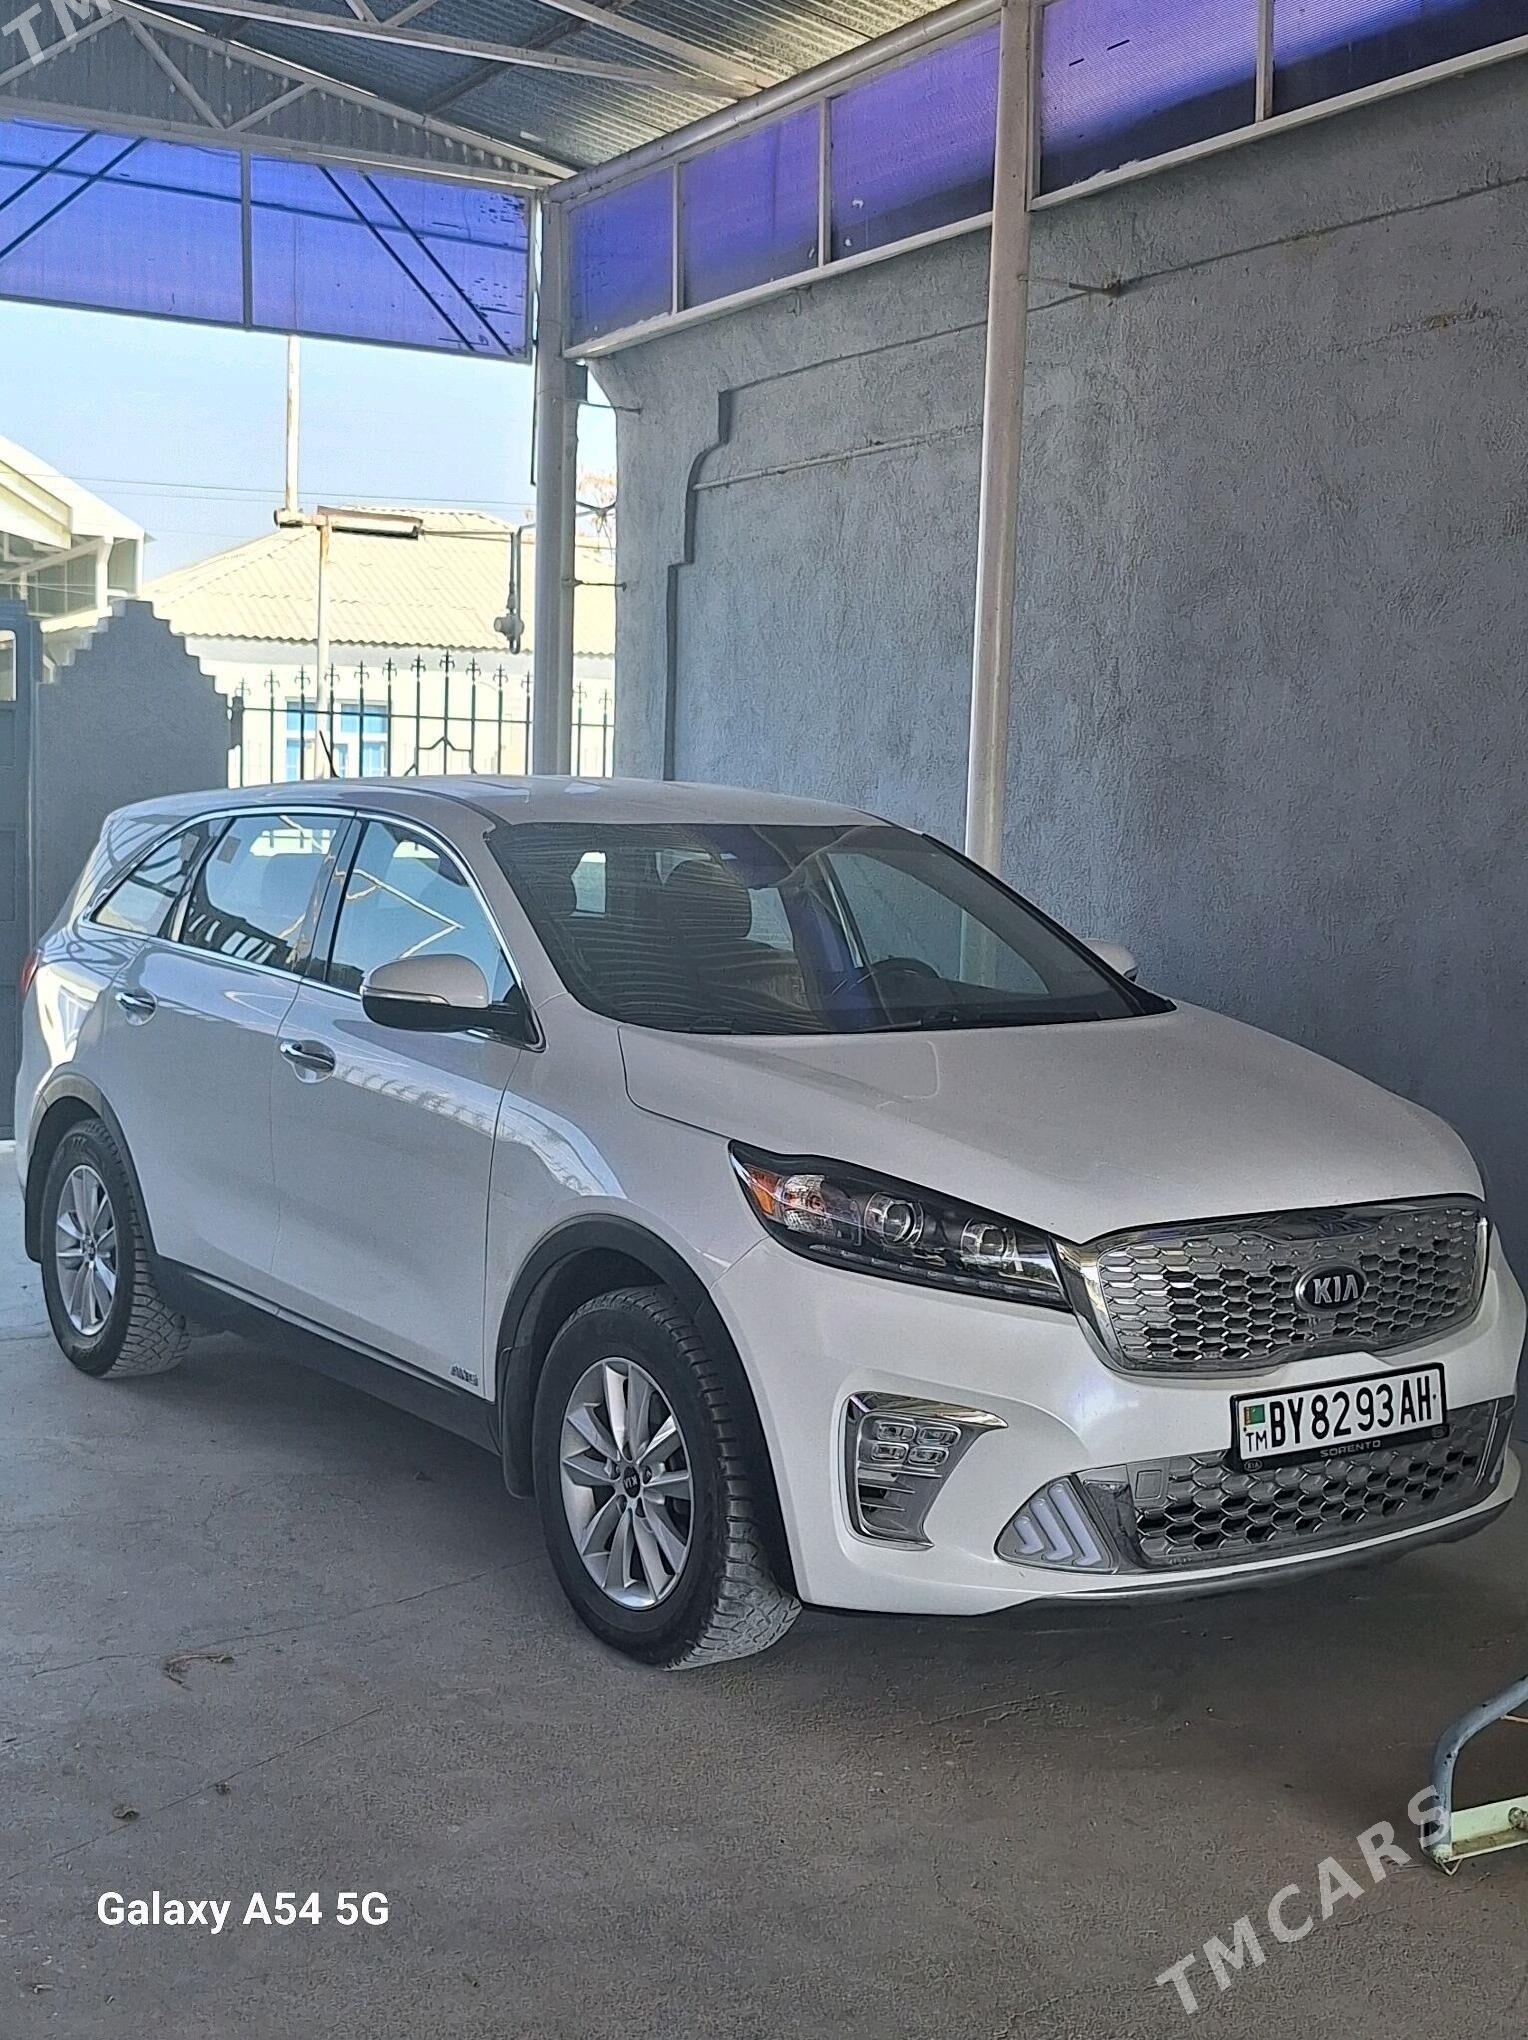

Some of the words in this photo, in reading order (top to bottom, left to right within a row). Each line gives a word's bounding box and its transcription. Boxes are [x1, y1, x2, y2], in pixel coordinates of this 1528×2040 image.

[1313, 1274, 1359, 1304] KIA
[1245, 1430, 1268, 1452] TM
[1320, 1440, 1381, 1457] SORENTO
